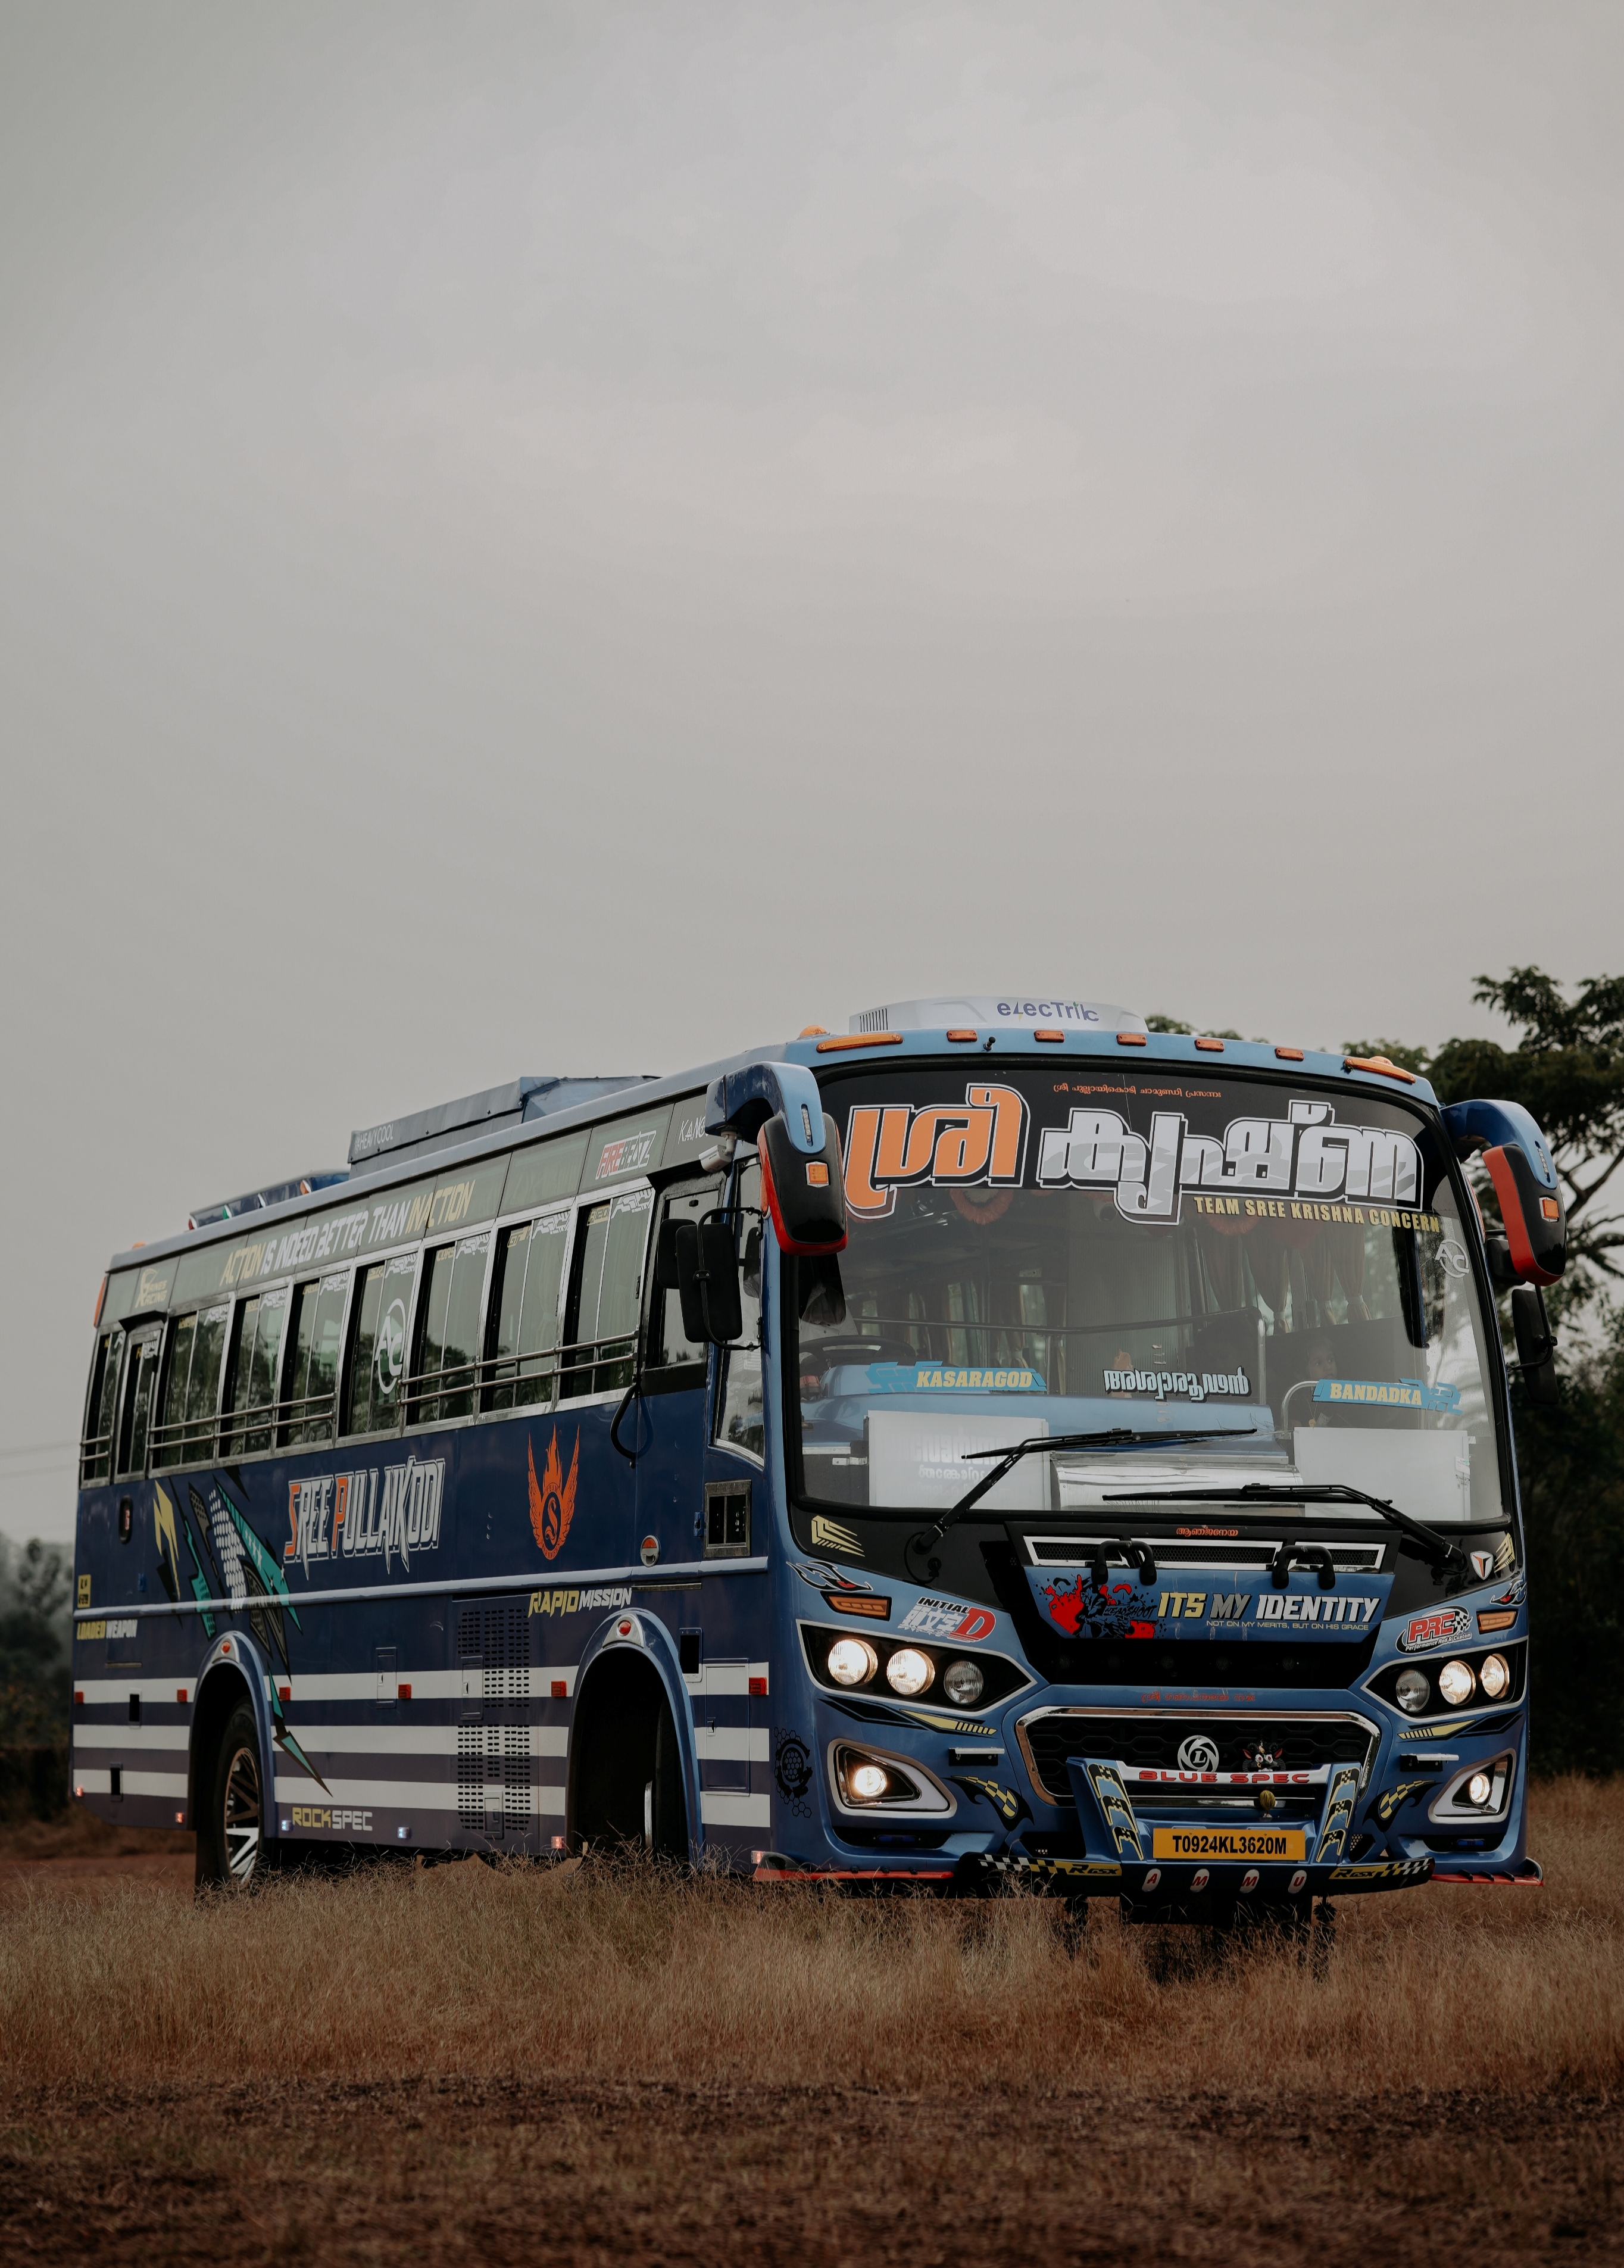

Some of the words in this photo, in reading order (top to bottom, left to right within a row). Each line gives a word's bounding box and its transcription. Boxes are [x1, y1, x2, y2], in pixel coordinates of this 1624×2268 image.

[1053, 1082, 1069, 1092] ശ്രീ
[1140, 1088, 1182, 1097] ചാമുണ്ഡി
[844, 1084, 1030, 1219] ശ്രീ
[1194, 1197, 1240, 1215] TEAM
[1245, 1199, 1286, 1218] SREE
[1291, 1202, 1365, 1225] KRISHNA
[1369, 1209, 1440, 1234] CONCERN
[218, 1242, 267, 1286] ACTION
[260, 1240, 277, 1276] IS
[274, 1226, 320, 1271] INDEED
[314, 1210, 369, 1259] BETTER
[368, 1200, 411, 1244] THAN
[405, 1180, 476, 1235] INACTION
[1435, 1241, 1470, 1277] AC
[374, 1310, 405, 1383] AC
[916, 1371, 1033, 1388] KASARAGOD
[1330, 1383, 1422, 1406] BANDADKA
[283, 1474, 334, 1581] SREE
[331, 1455, 445, 1574] PULLAIKODI
[527, 1590, 580, 1618] RAPID
[577, 1587, 632, 1612] MISSION
[1157, 1592, 1207, 1619] ITS
[1210, 1593, 1251, 1619] MY
[1256, 1593, 1381, 1623] IDENTITY
[77, 1620, 107, 1641] LOADED
[105, 1618, 138, 1639] WEAPON
[917, 1597, 970, 1614] INITIAL
[948, 1606, 996, 1643] D
[1408, 1612, 1455, 1643] PRC
[1405, 1640, 1438, 1652] Performance
[1453, 1633, 1471, 1641] Custom
[1141, 1690, 1160, 1703] ശ്രീ
[1139, 1771, 1218, 1783] BLUE
[1230, 1773, 1310, 1783] SPEC
[292, 1807, 332, 1829] ROCK
[332, 1810, 373, 1832] SPEC
[1172, 1835, 1286, 1854] T0924KL3620M
